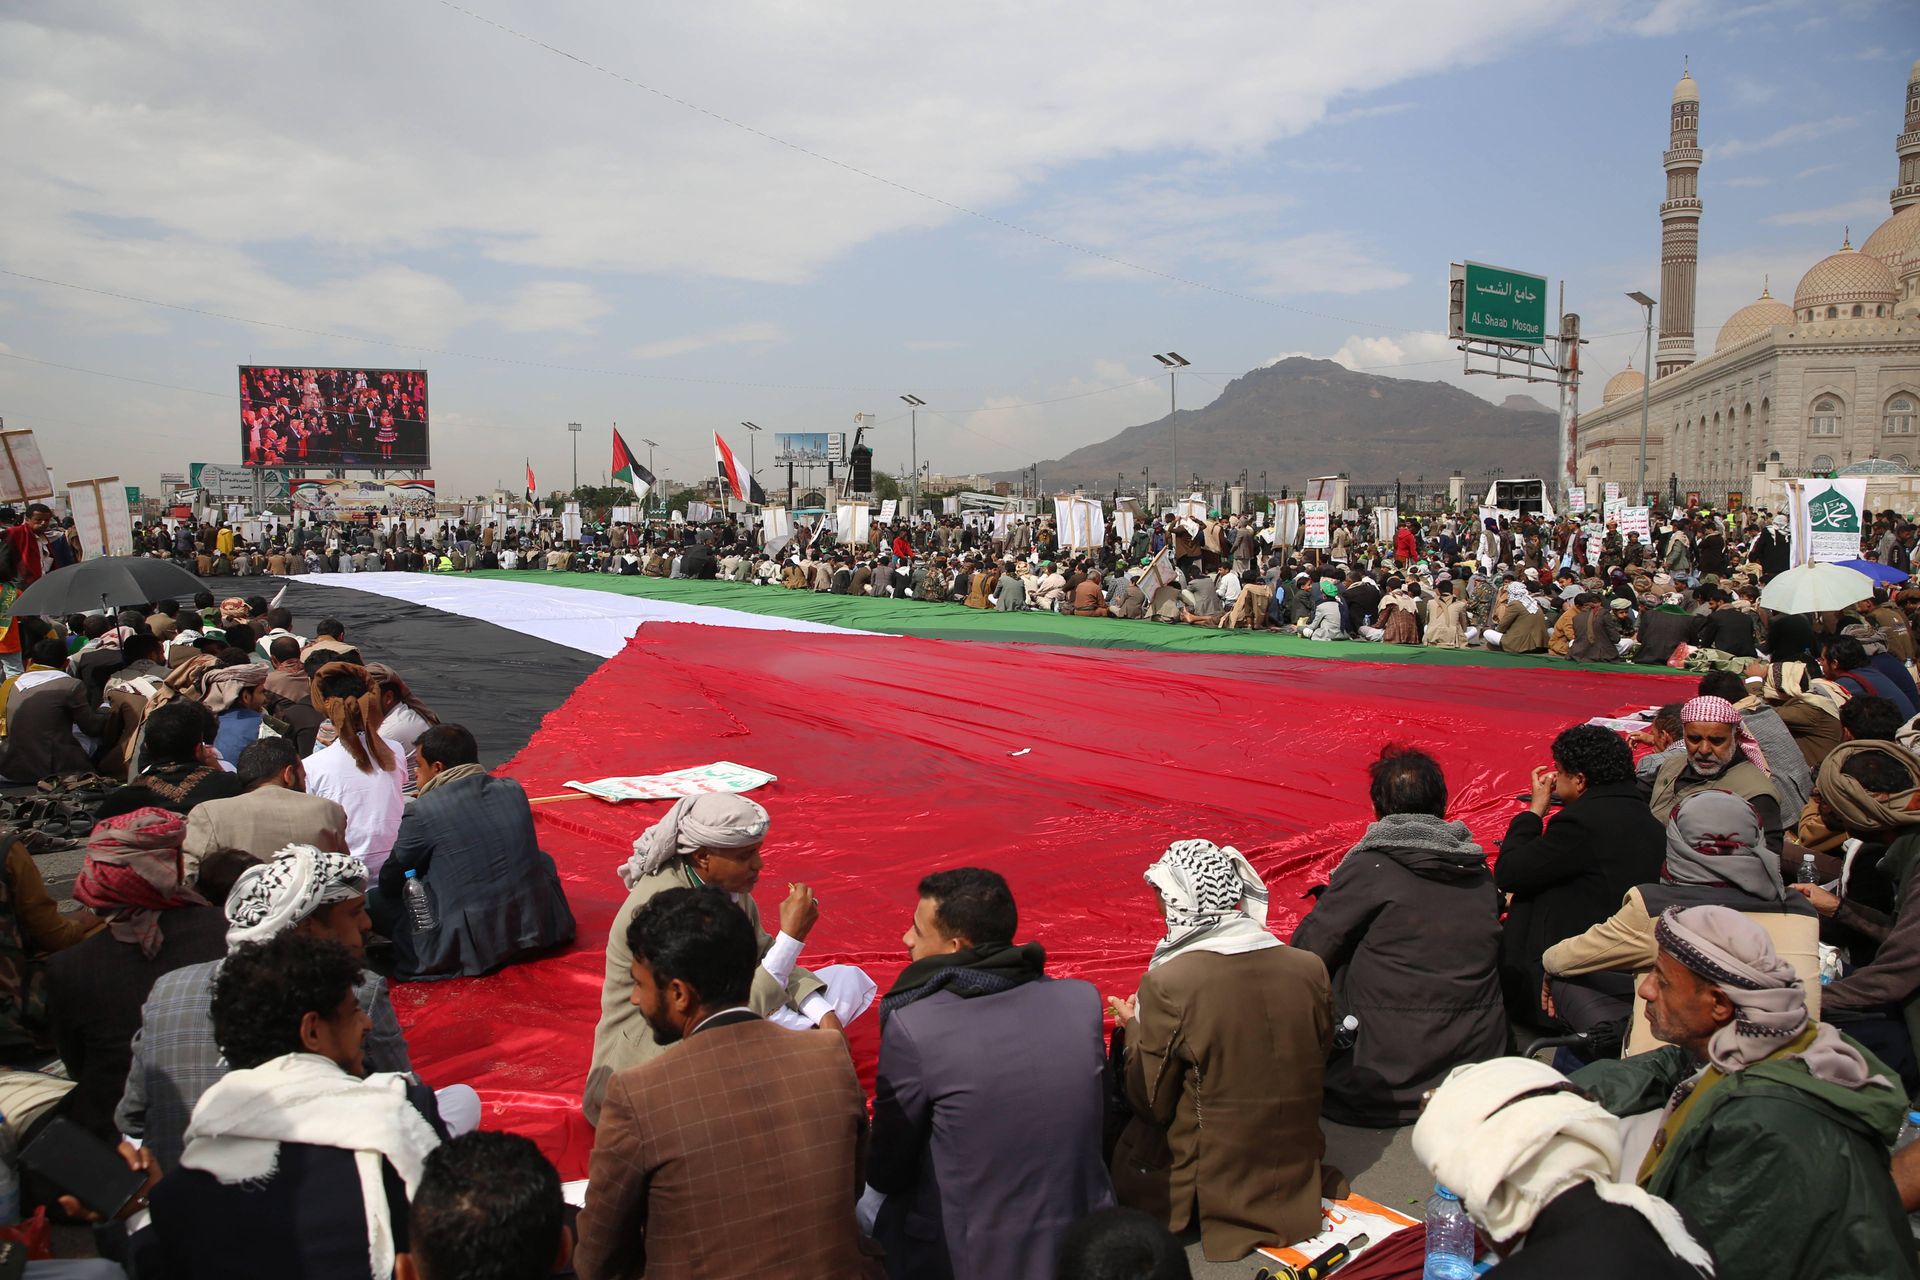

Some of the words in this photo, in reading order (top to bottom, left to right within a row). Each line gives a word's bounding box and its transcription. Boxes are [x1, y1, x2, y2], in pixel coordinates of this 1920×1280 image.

[1476, 281, 1512, 296] الشعب
[1514, 286, 1536, 304] جامع
[1484, 313, 1508, 328] Shaab
[1512, 318, 1539, 334] Mosque
